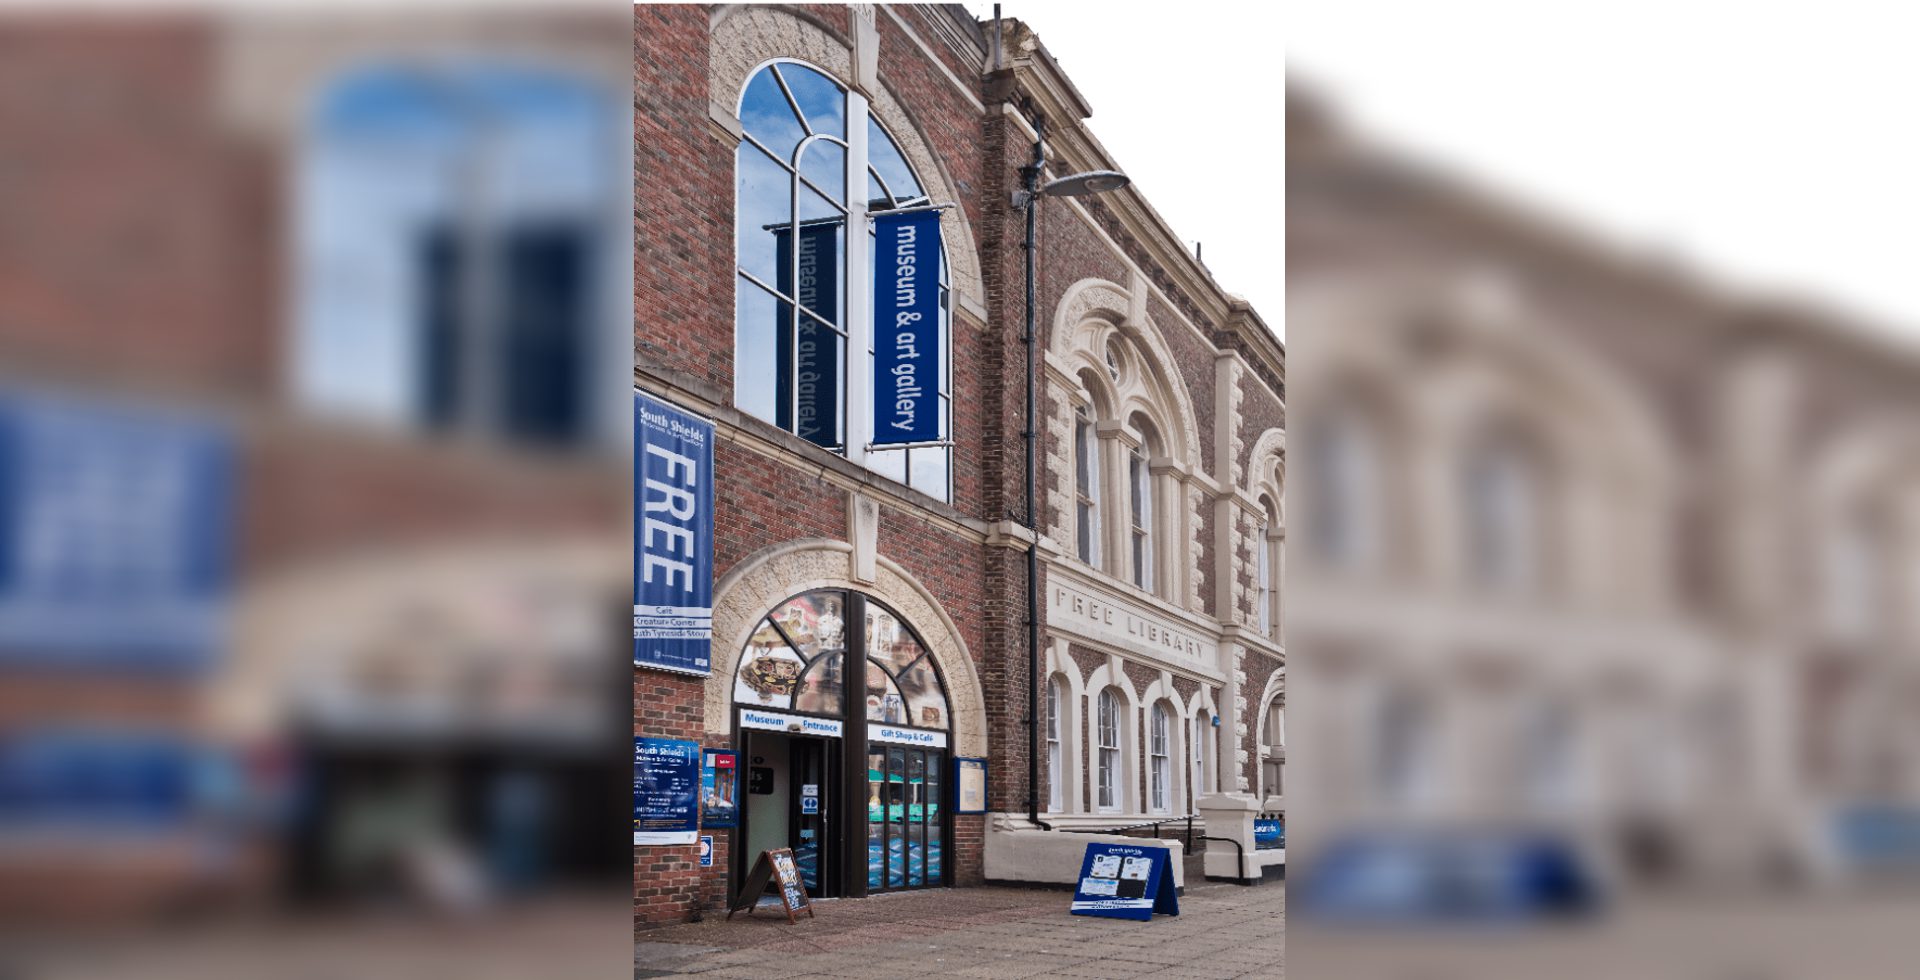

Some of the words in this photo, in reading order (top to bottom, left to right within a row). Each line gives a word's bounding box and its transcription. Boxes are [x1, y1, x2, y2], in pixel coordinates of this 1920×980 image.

[896, 225, 916, 308] museum
[896, 311, 922, 328] &
[896, 331, 920, 360] art
[891, 363, 922, 432] gallery
[640, 407, 668, 428] South
[670, 420, 704, 442] Shields
[643, 442, 696, 593] FREE
[634, 629, 651, 637] outh
[637, 617, 669, 625] Creature
[1056, 588, 1113, 626] FREE
[1127, 616, 1203, 658] LIBRARY
[745, 713, 784, 726] Museum
[803, 720, 838, 732] Entrance
[881, 729, 894, 738] Gift
[895, 730, 913, 741] Shop
[920, 733, 933, 741] Café
[635, 745, 658, 754] South
[660, 747, 685, 757] Shields
